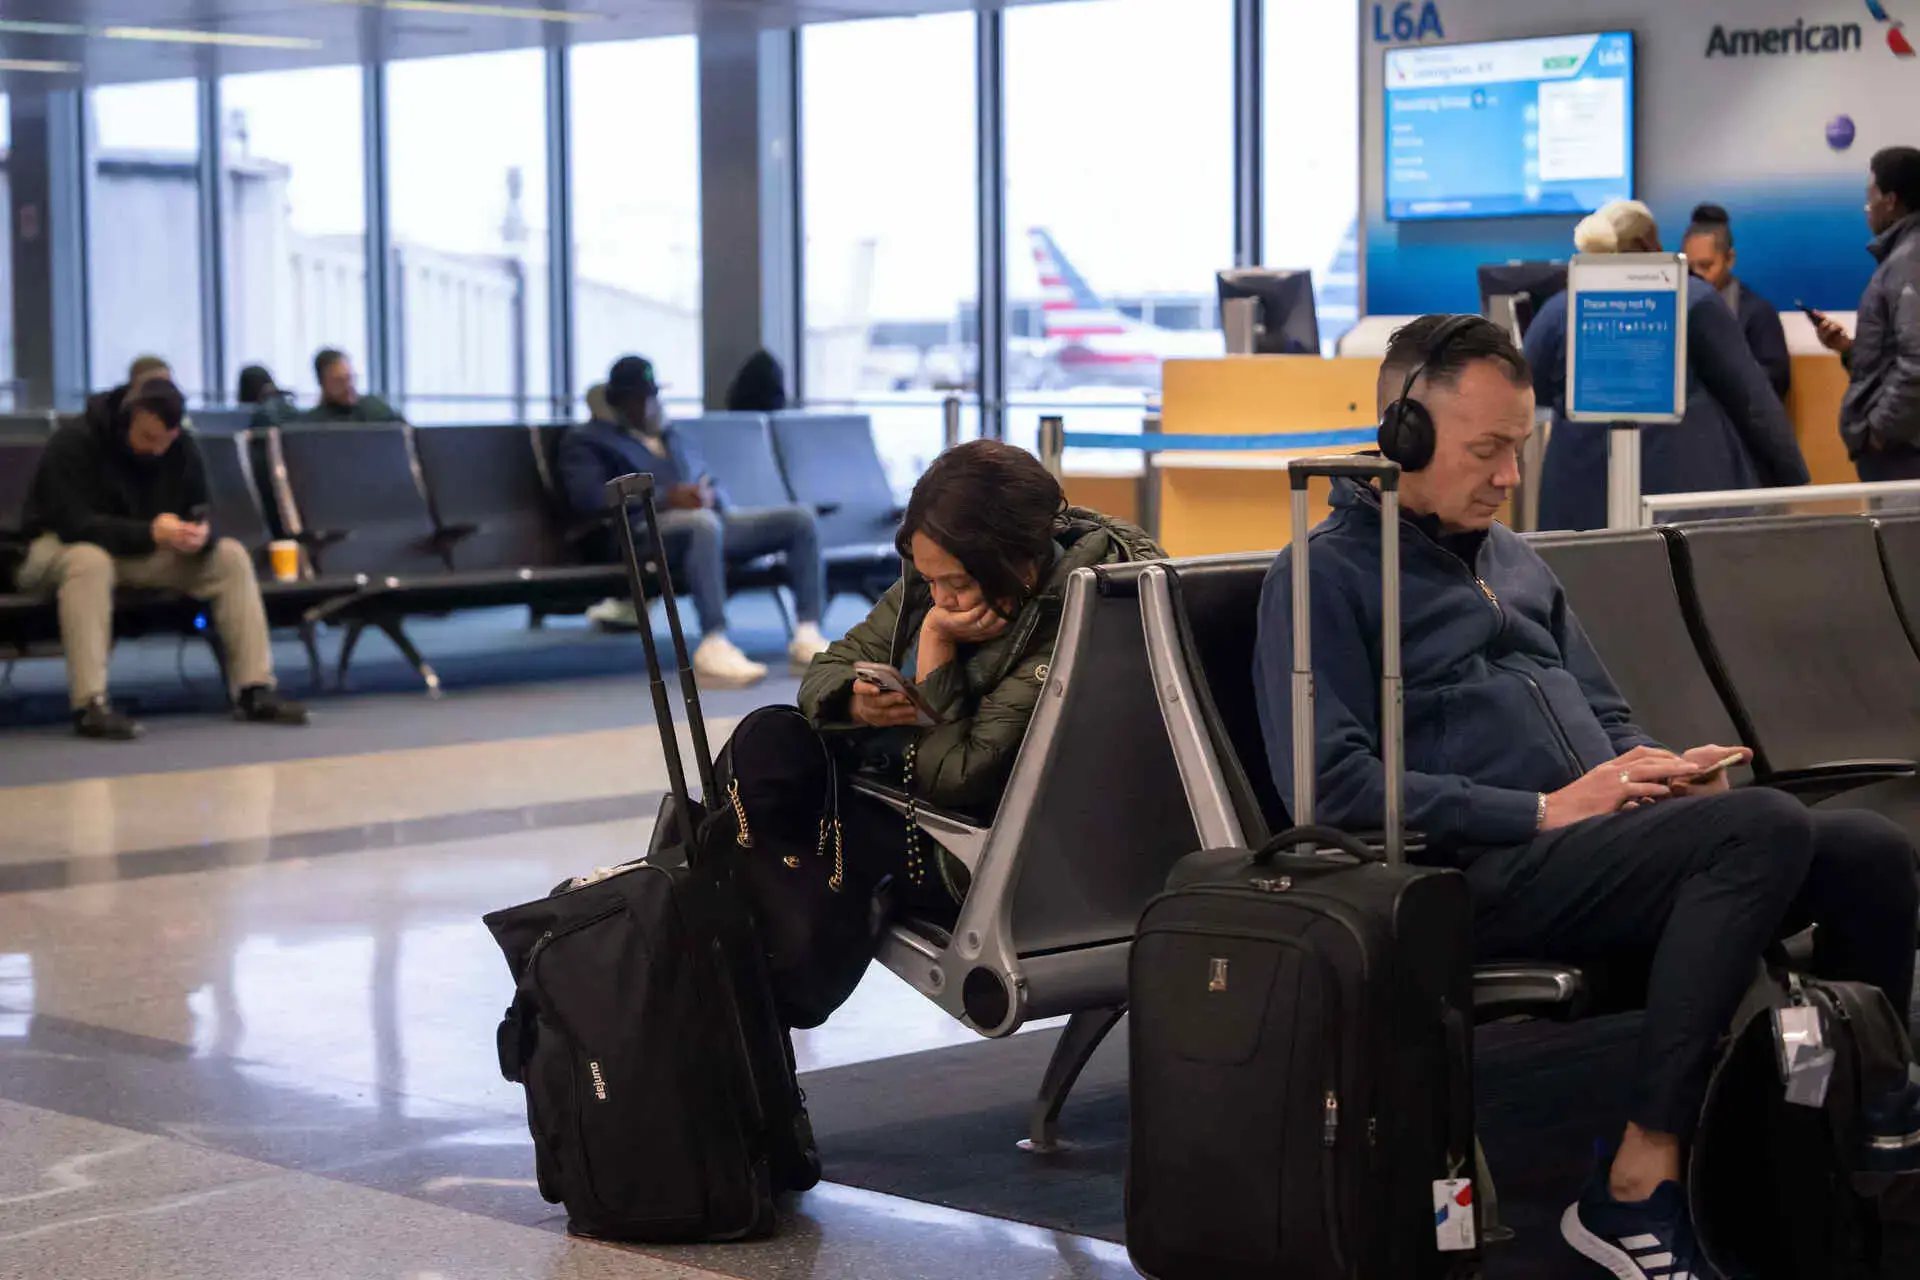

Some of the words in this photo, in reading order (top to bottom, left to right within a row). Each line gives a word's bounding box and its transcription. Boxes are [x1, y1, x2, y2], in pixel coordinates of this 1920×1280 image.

[1372, 0, 1445, 42] L6A
[1704, 16, 1862, 58] American
[1609, 300, 1627, 313] may
[590, 1061, 607, 1100] dejuno
